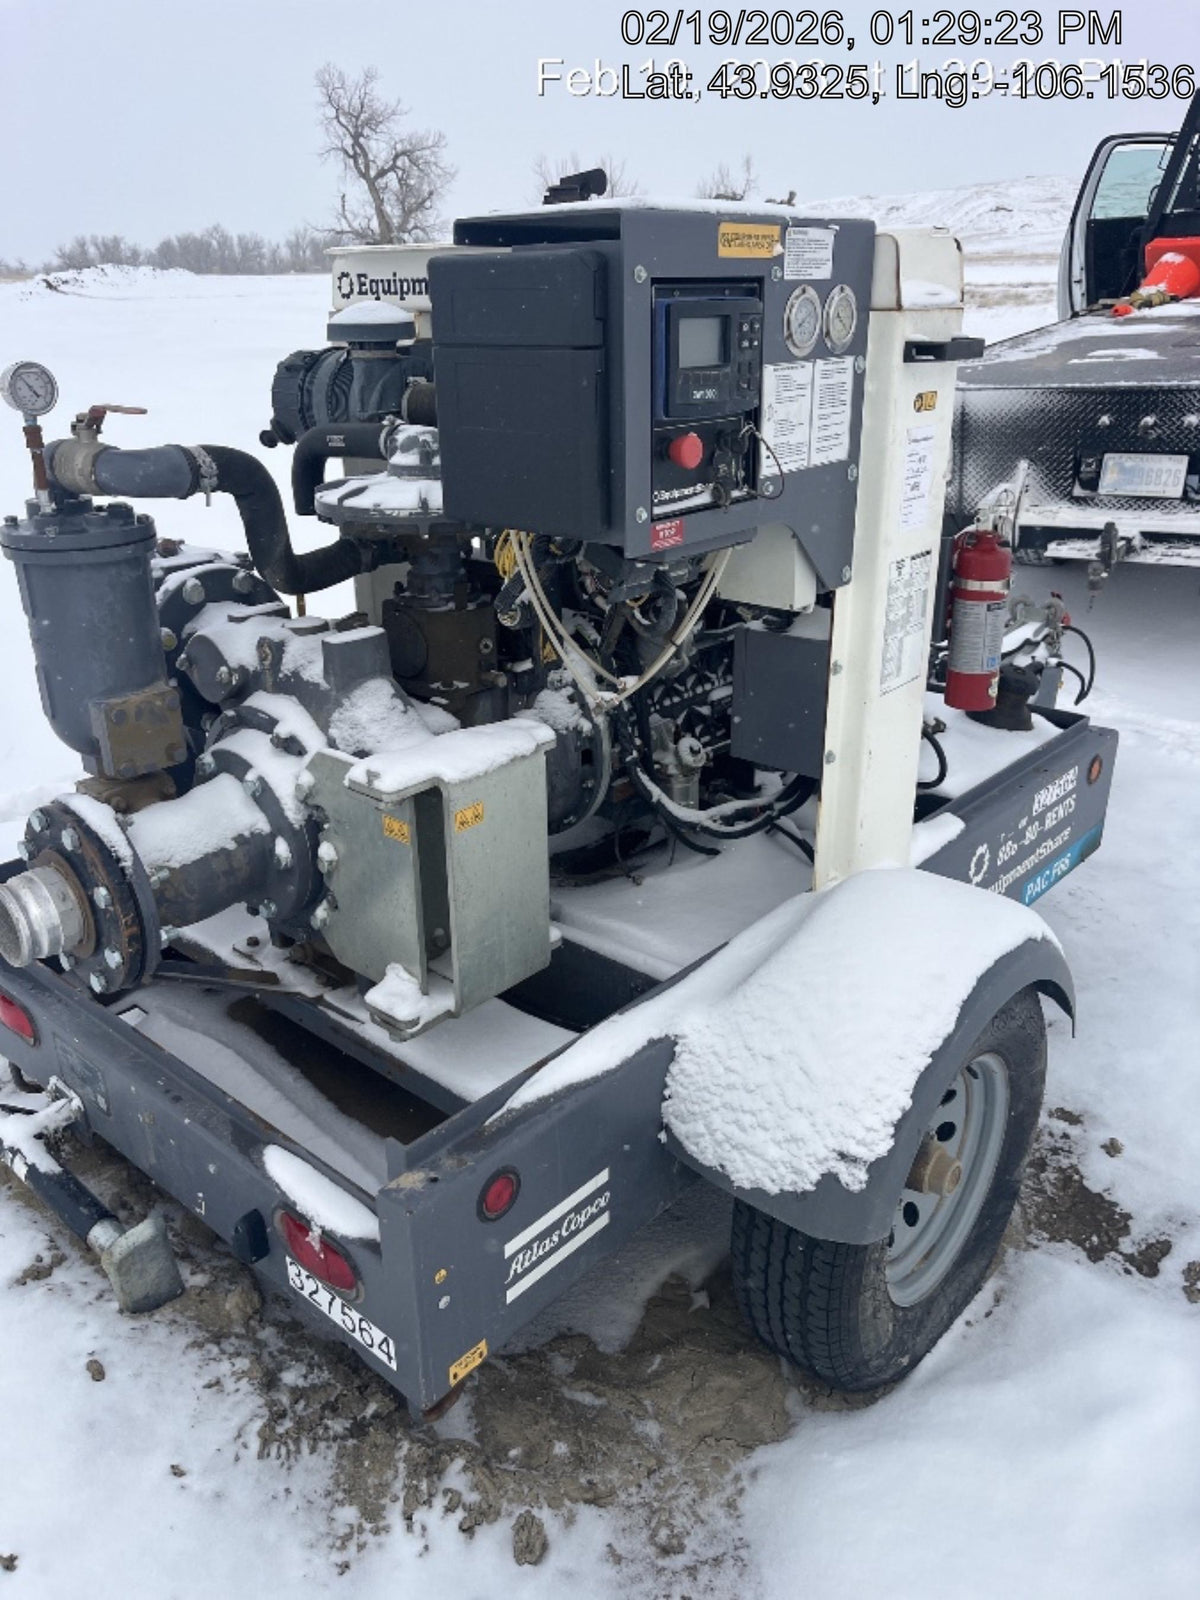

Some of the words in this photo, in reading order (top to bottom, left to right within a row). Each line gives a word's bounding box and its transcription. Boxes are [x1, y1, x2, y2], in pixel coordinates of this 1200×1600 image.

[504, 1229, 561, 1285] Atlas
[561, 1191, 611, 1238] Copco
[288, 1260, 394, 1365] 327564
